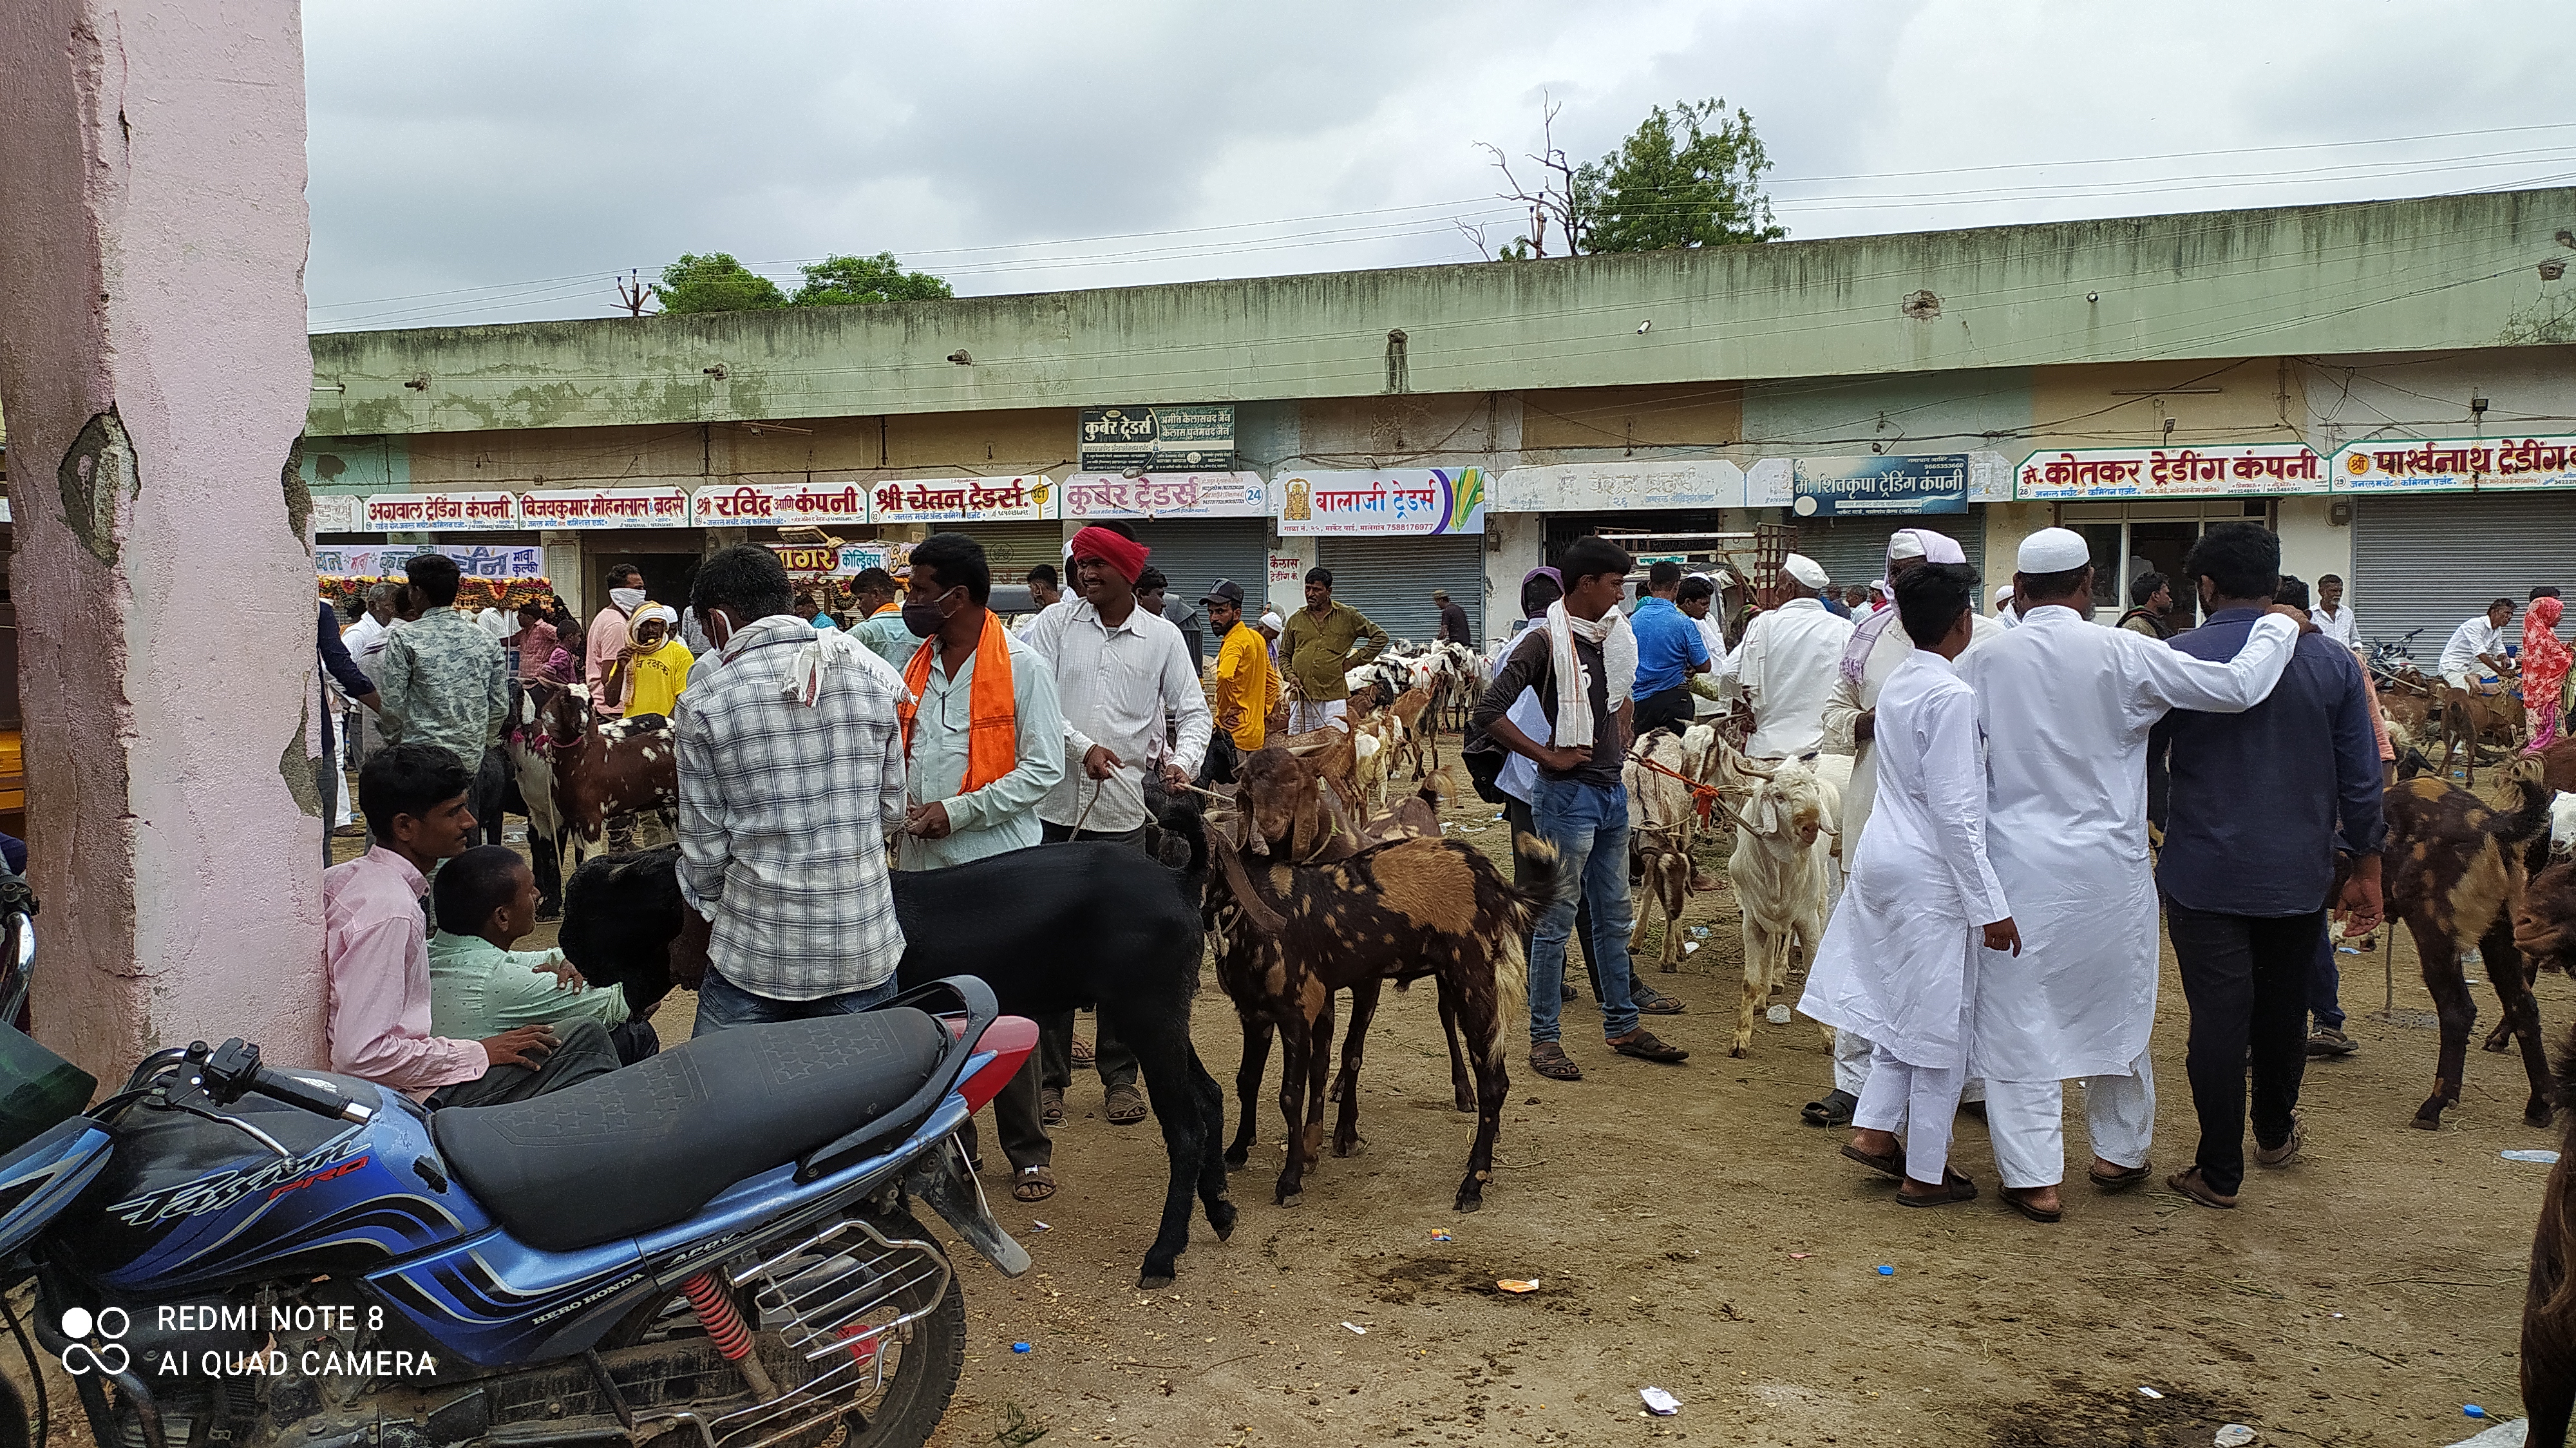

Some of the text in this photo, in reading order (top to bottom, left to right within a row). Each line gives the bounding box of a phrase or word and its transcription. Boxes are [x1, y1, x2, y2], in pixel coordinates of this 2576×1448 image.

[1084, 414, 1153, 441] कुबेर ट्रेडर्स
[1217, 410, 1231, 423] जैन
[1161, 425, 1186, 437] कैलास
[1217, 424, 1230, 436] जैन
[2022, 466, 2044, 485] मे.
[2045, 453, 2145, 488] कोतकर
[2150, 451, 2228, 488] ट्रेडींग
[2351, 458, 2367, 473] श्री
[2499, 439, 2568, 475] ट्रेडींग
[1032, 489, 1046, 500] SCT
[1247, 490, 1262, 500] 24
[1817, 471, 1875, 500] शिवकृपा
[1879, 470, 1916, 499] ट्रेडिंग
[1919, 468, 1964, 492] कंपनी
[2088, 486, 2116, 495] कमिशन
[2400, 477, 2431, 487] कमिशन
[368, 502, 424, 521] अग्रवाल
[425, 495, 463, 521] ट्रेडिंग
[521, 495, 590, 520] विजयकुमार
[591, 493, 650, 518] मोहनलाल
[654, 490, 686, 517] ब्रदर्स
[694, 497, 712, 516] श्री
[714, 486, 773, 518] रविंद्र
[773, 495, 795, 511] आणि
[875, 483, 903, 515] श्री
[906, 484, 967, 511] चेतन
[1067, 476, 1199, 515] कुबेर ट्रेडर्स
[1316, 479, 1437, 520] बालाजी ट्रेडर्स
[512, 562, 539, 577] कुल्फी
[513, 549, 534, 564] मावा
[1269, 555, 1300, 570] कैलास
[1269, 570, 1290, 582] ट्रेडींग
[647, 658, 670, 676] रक्षक
[106, 1141, 372, 1226] Passion
[268, 1156, 370, 1201] PRO
[532, 1273, 645, 1325] HERO HONDA
